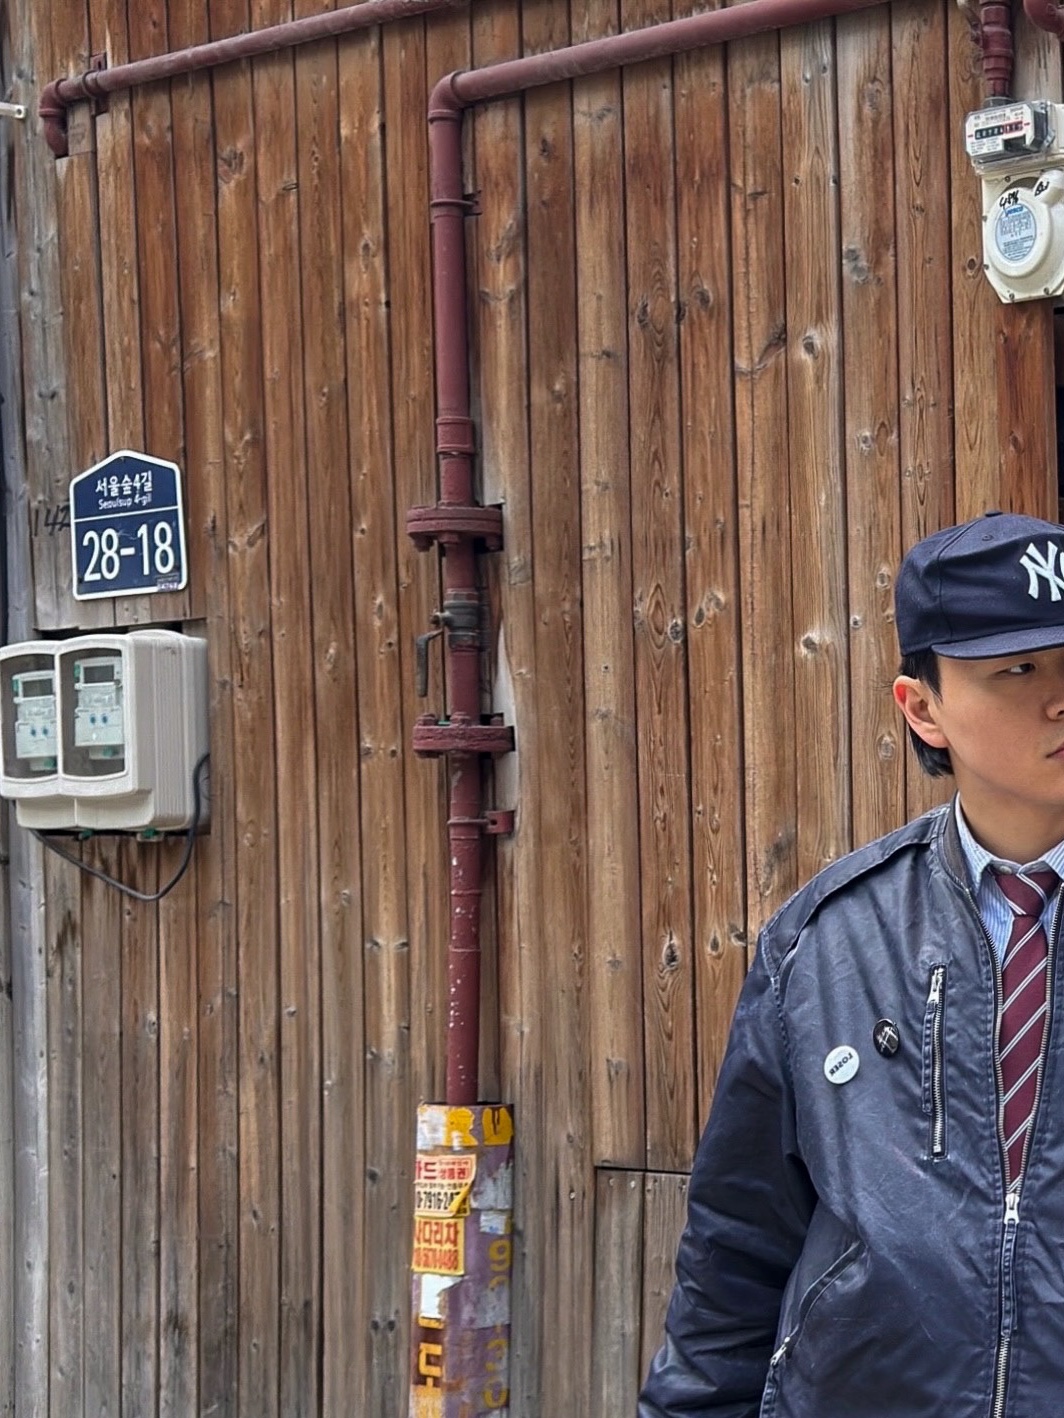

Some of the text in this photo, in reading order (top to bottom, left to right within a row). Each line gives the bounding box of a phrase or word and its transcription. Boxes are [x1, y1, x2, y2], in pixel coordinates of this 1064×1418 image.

[95, 470, 152, 497] 서울숲4길
[98, 493, 152, 510] Seoulsup 4-gil
[82, 521, 175, 582] 28-18
